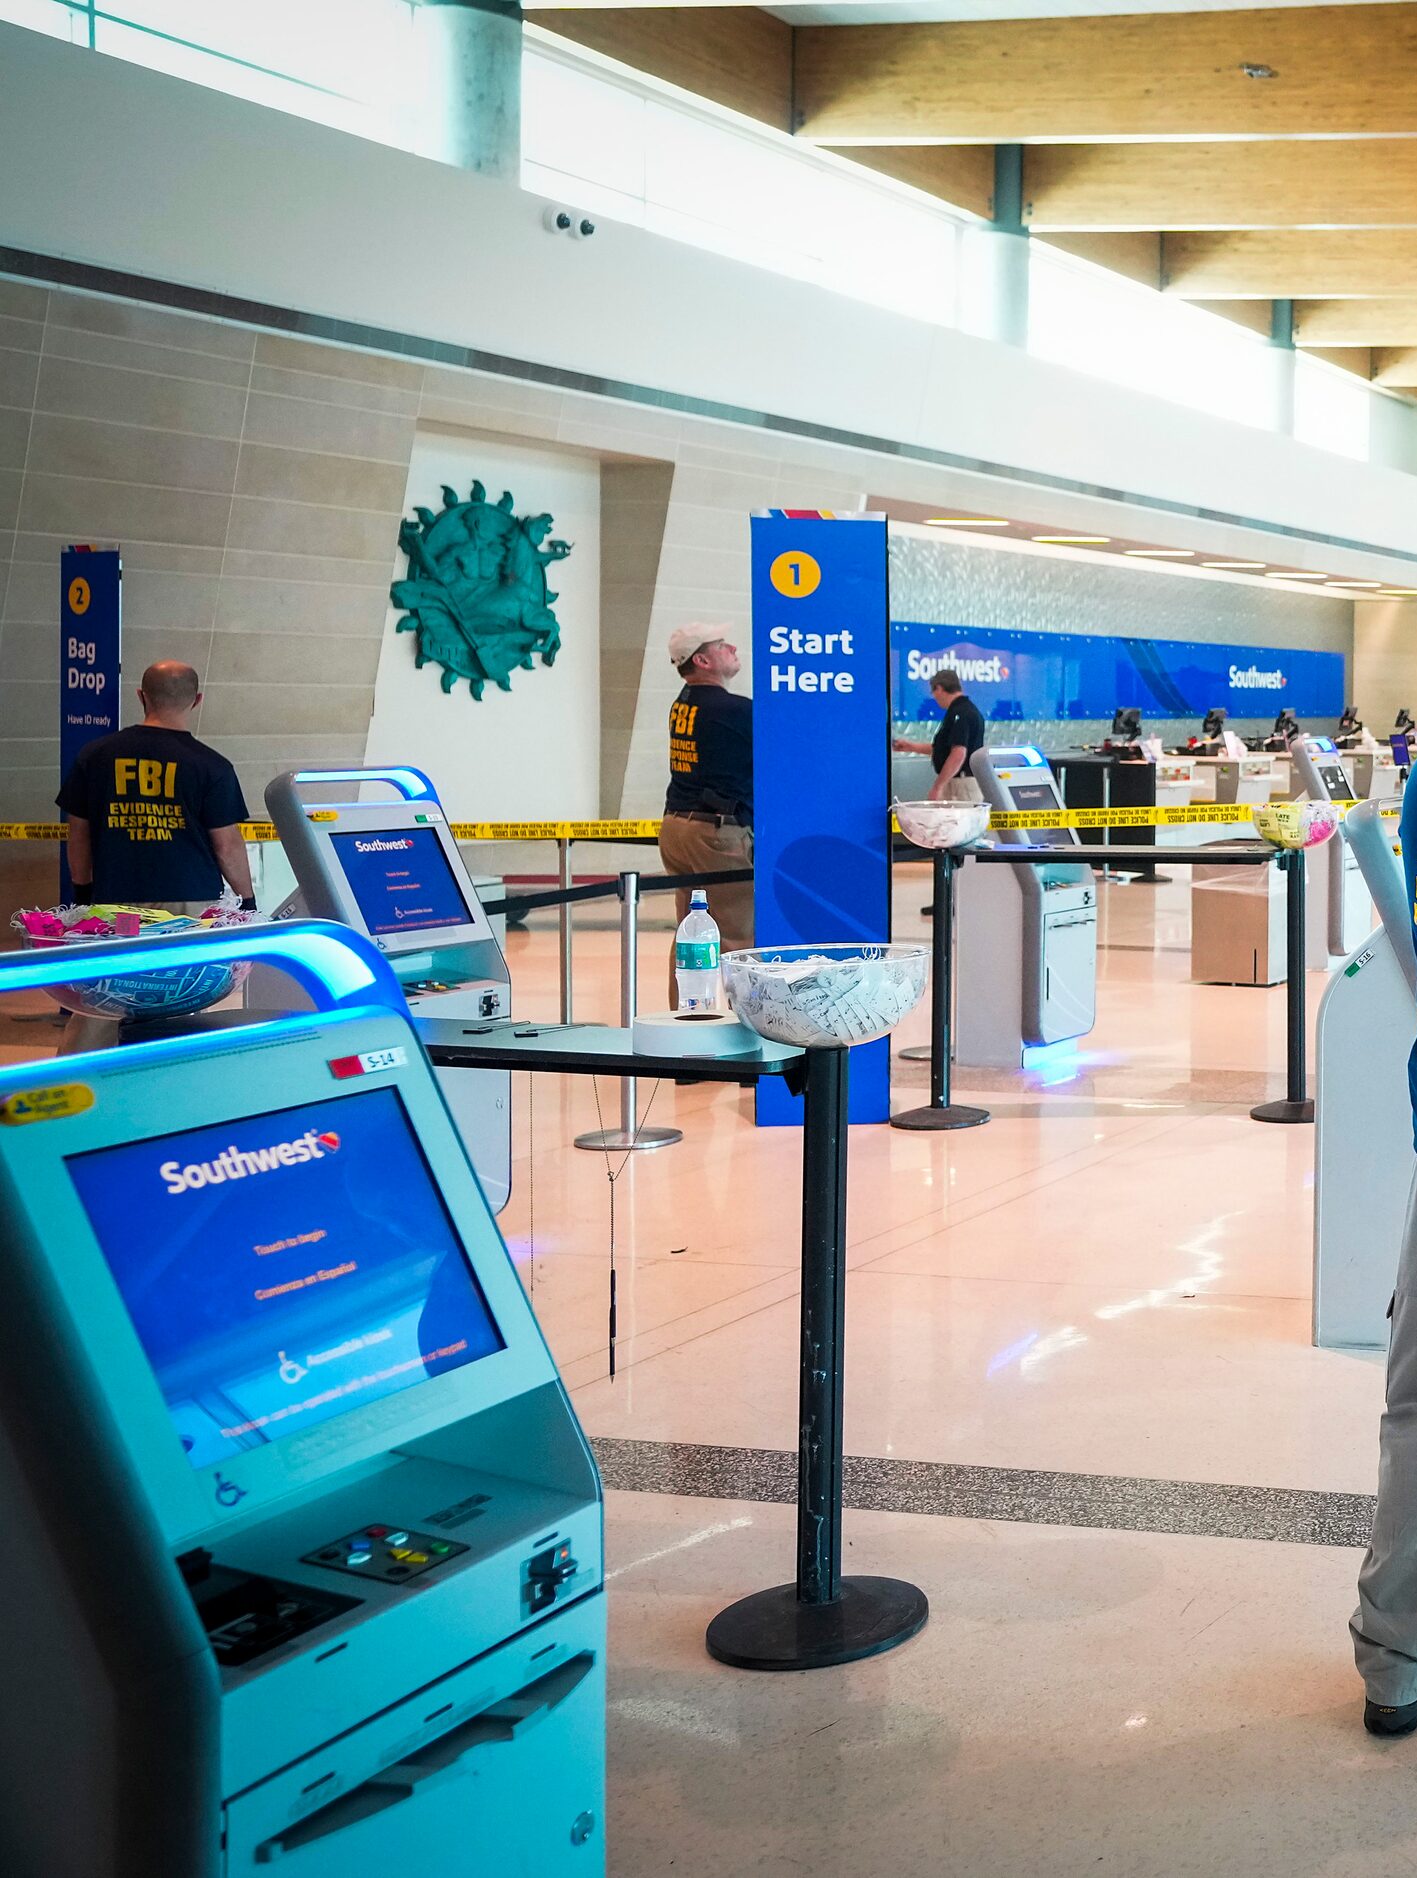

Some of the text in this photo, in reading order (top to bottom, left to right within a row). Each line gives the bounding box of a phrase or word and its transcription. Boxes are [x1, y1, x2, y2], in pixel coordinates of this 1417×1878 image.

[789, 563, 801, 587] 1
[75, 586, 84, 605] 2
[67, 637, 96, 665] Bag
[769, 626, 854, 655] Start
[907, 649, 1002, 683] Southwest
[1228, 664, 1283, 689] Southwest
[67, 667, 106, 695] Drop
[770, 665, 855, 693] Here
[67, 714, 111, 727] Have ID ready
[669, 701, 699, 736] FBI
[114, 758, 178, 799] FBI
[109, 802, 183, 817] EVIDENCE
[107, 815, 186, 829] RESPONSE
[127, 828, 172, 841] TEAM
[355, 838, 408, 853] Southwest
[1357, 951, 1372, 966] S-16
[113, 977, 178, 991] INTERNATIONAL
[366, 1052, 395, 1068] S-14
[159, 1131, 325, 1194] Southwest
